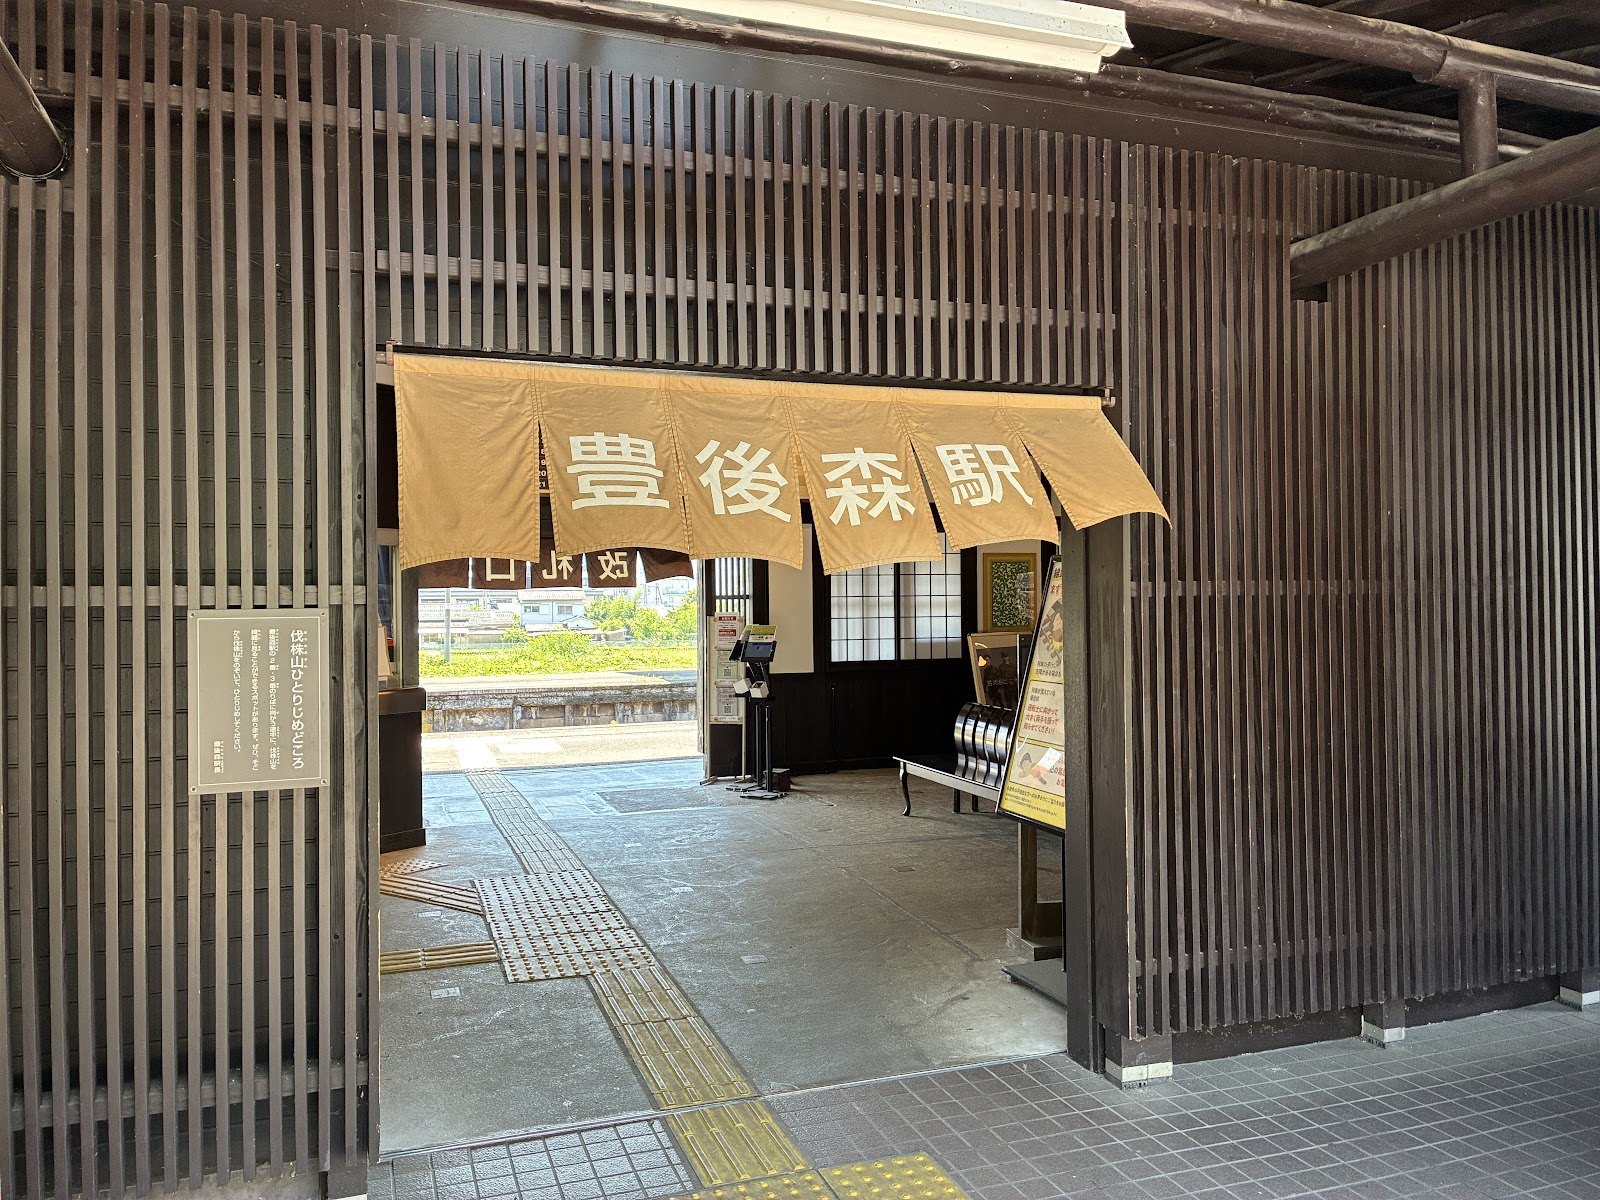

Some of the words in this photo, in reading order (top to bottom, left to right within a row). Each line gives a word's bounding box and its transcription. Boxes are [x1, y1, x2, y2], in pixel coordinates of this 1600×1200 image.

[567, 432, 1033, 526] 豊後森駅
[291, 630, 304, 770] 伐株山ひとりじめどころ
